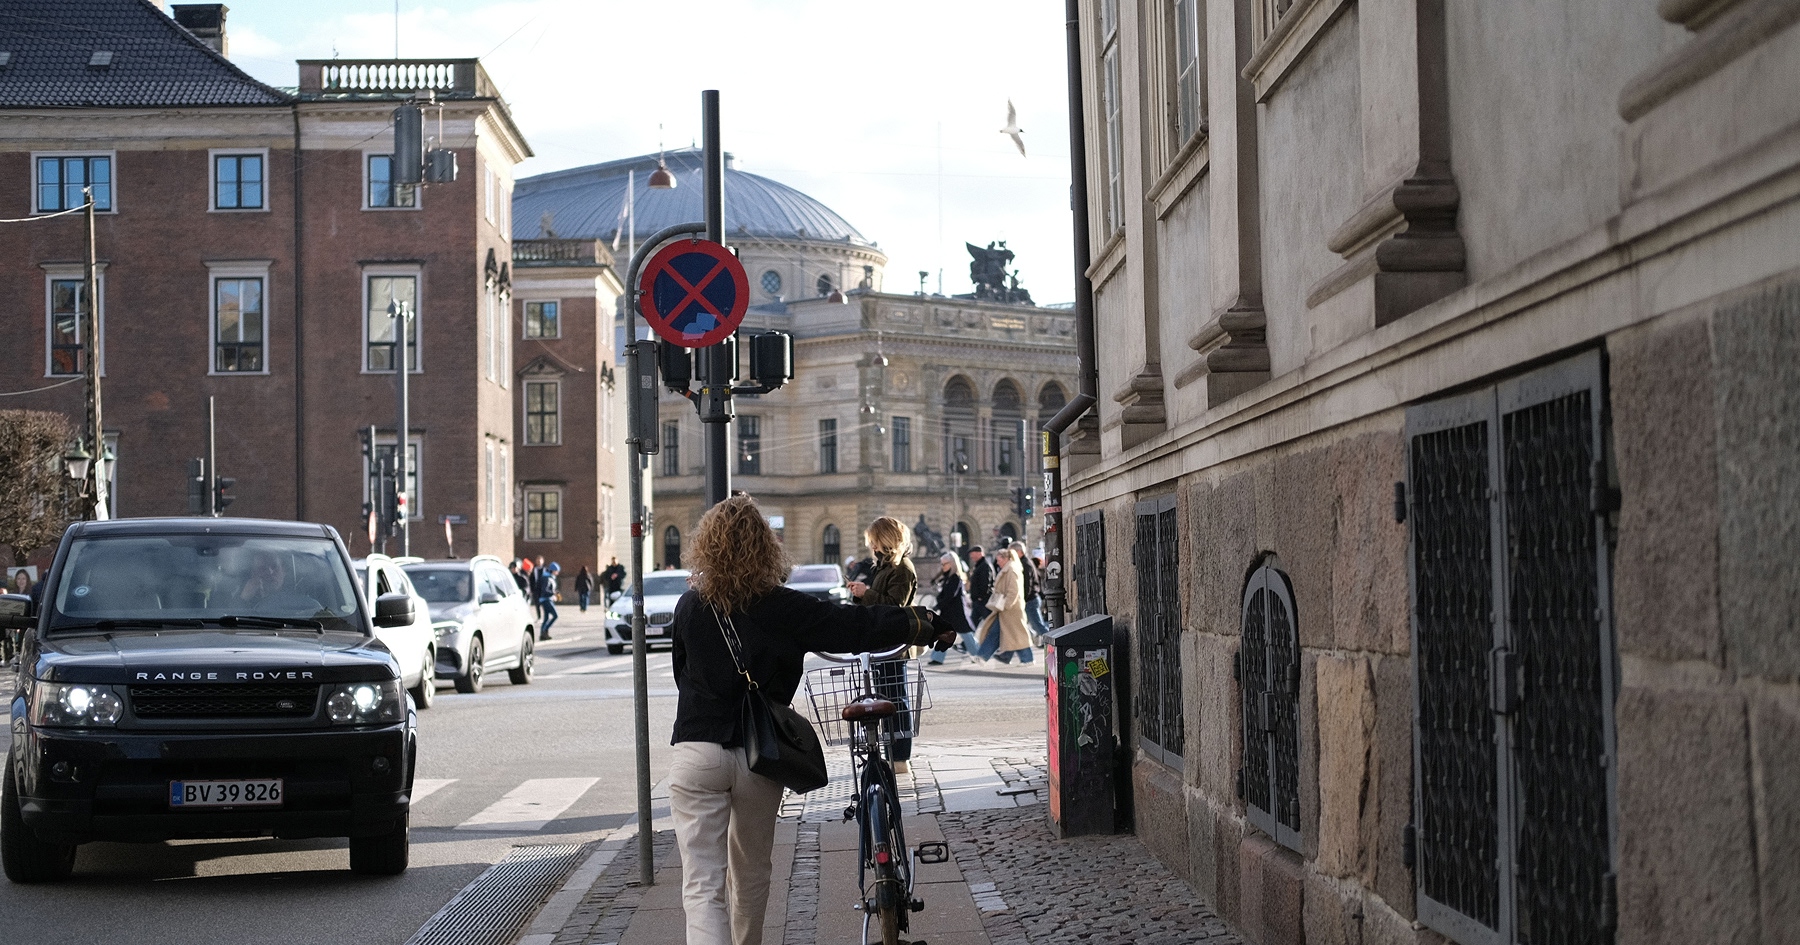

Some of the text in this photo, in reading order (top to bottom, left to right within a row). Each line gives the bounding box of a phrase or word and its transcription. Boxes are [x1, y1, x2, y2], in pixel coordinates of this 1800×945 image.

[136, 671, 313, 680] RANGE ROVER
[185, 783, 280, 802] BV 39 826
